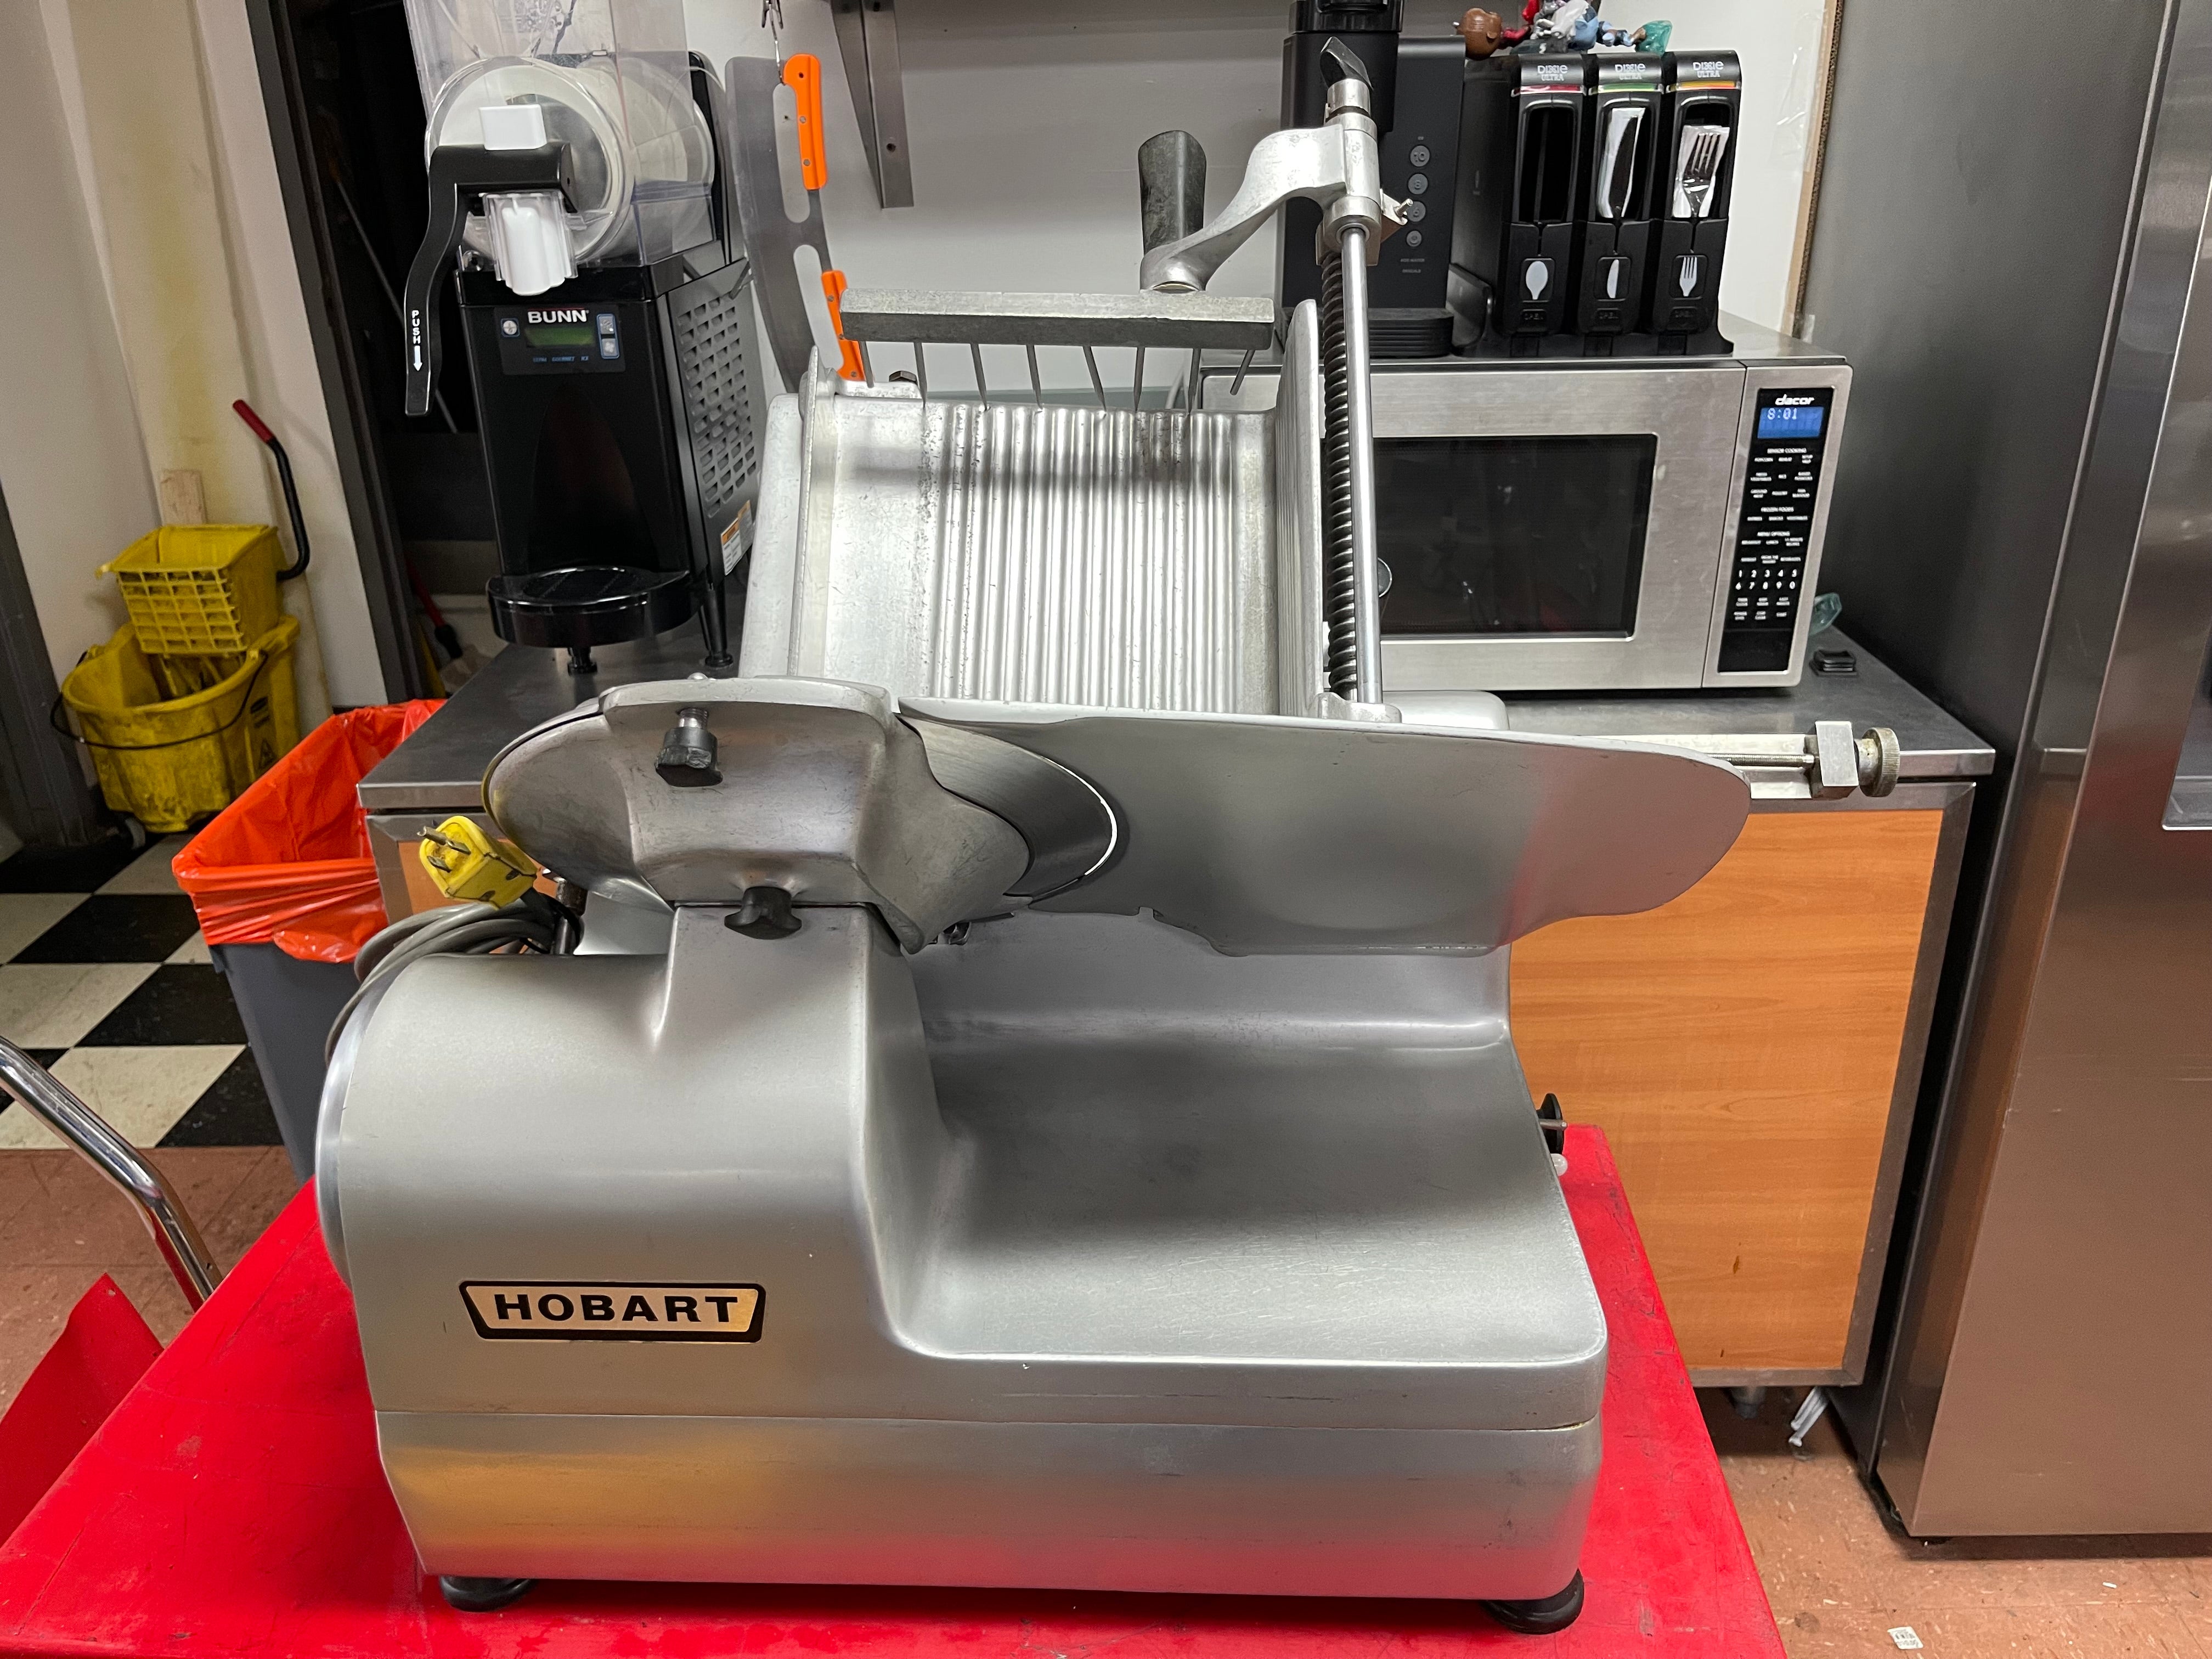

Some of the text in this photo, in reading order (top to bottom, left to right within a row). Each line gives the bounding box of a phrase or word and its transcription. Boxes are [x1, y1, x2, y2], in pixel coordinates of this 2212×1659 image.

[411, 310, 421, 344] PUSH
[527, 310, 588, 324] BUNN
[1775, 394, 1815, 405] dacor
[494, 1293, 738, 1323] HOBART
